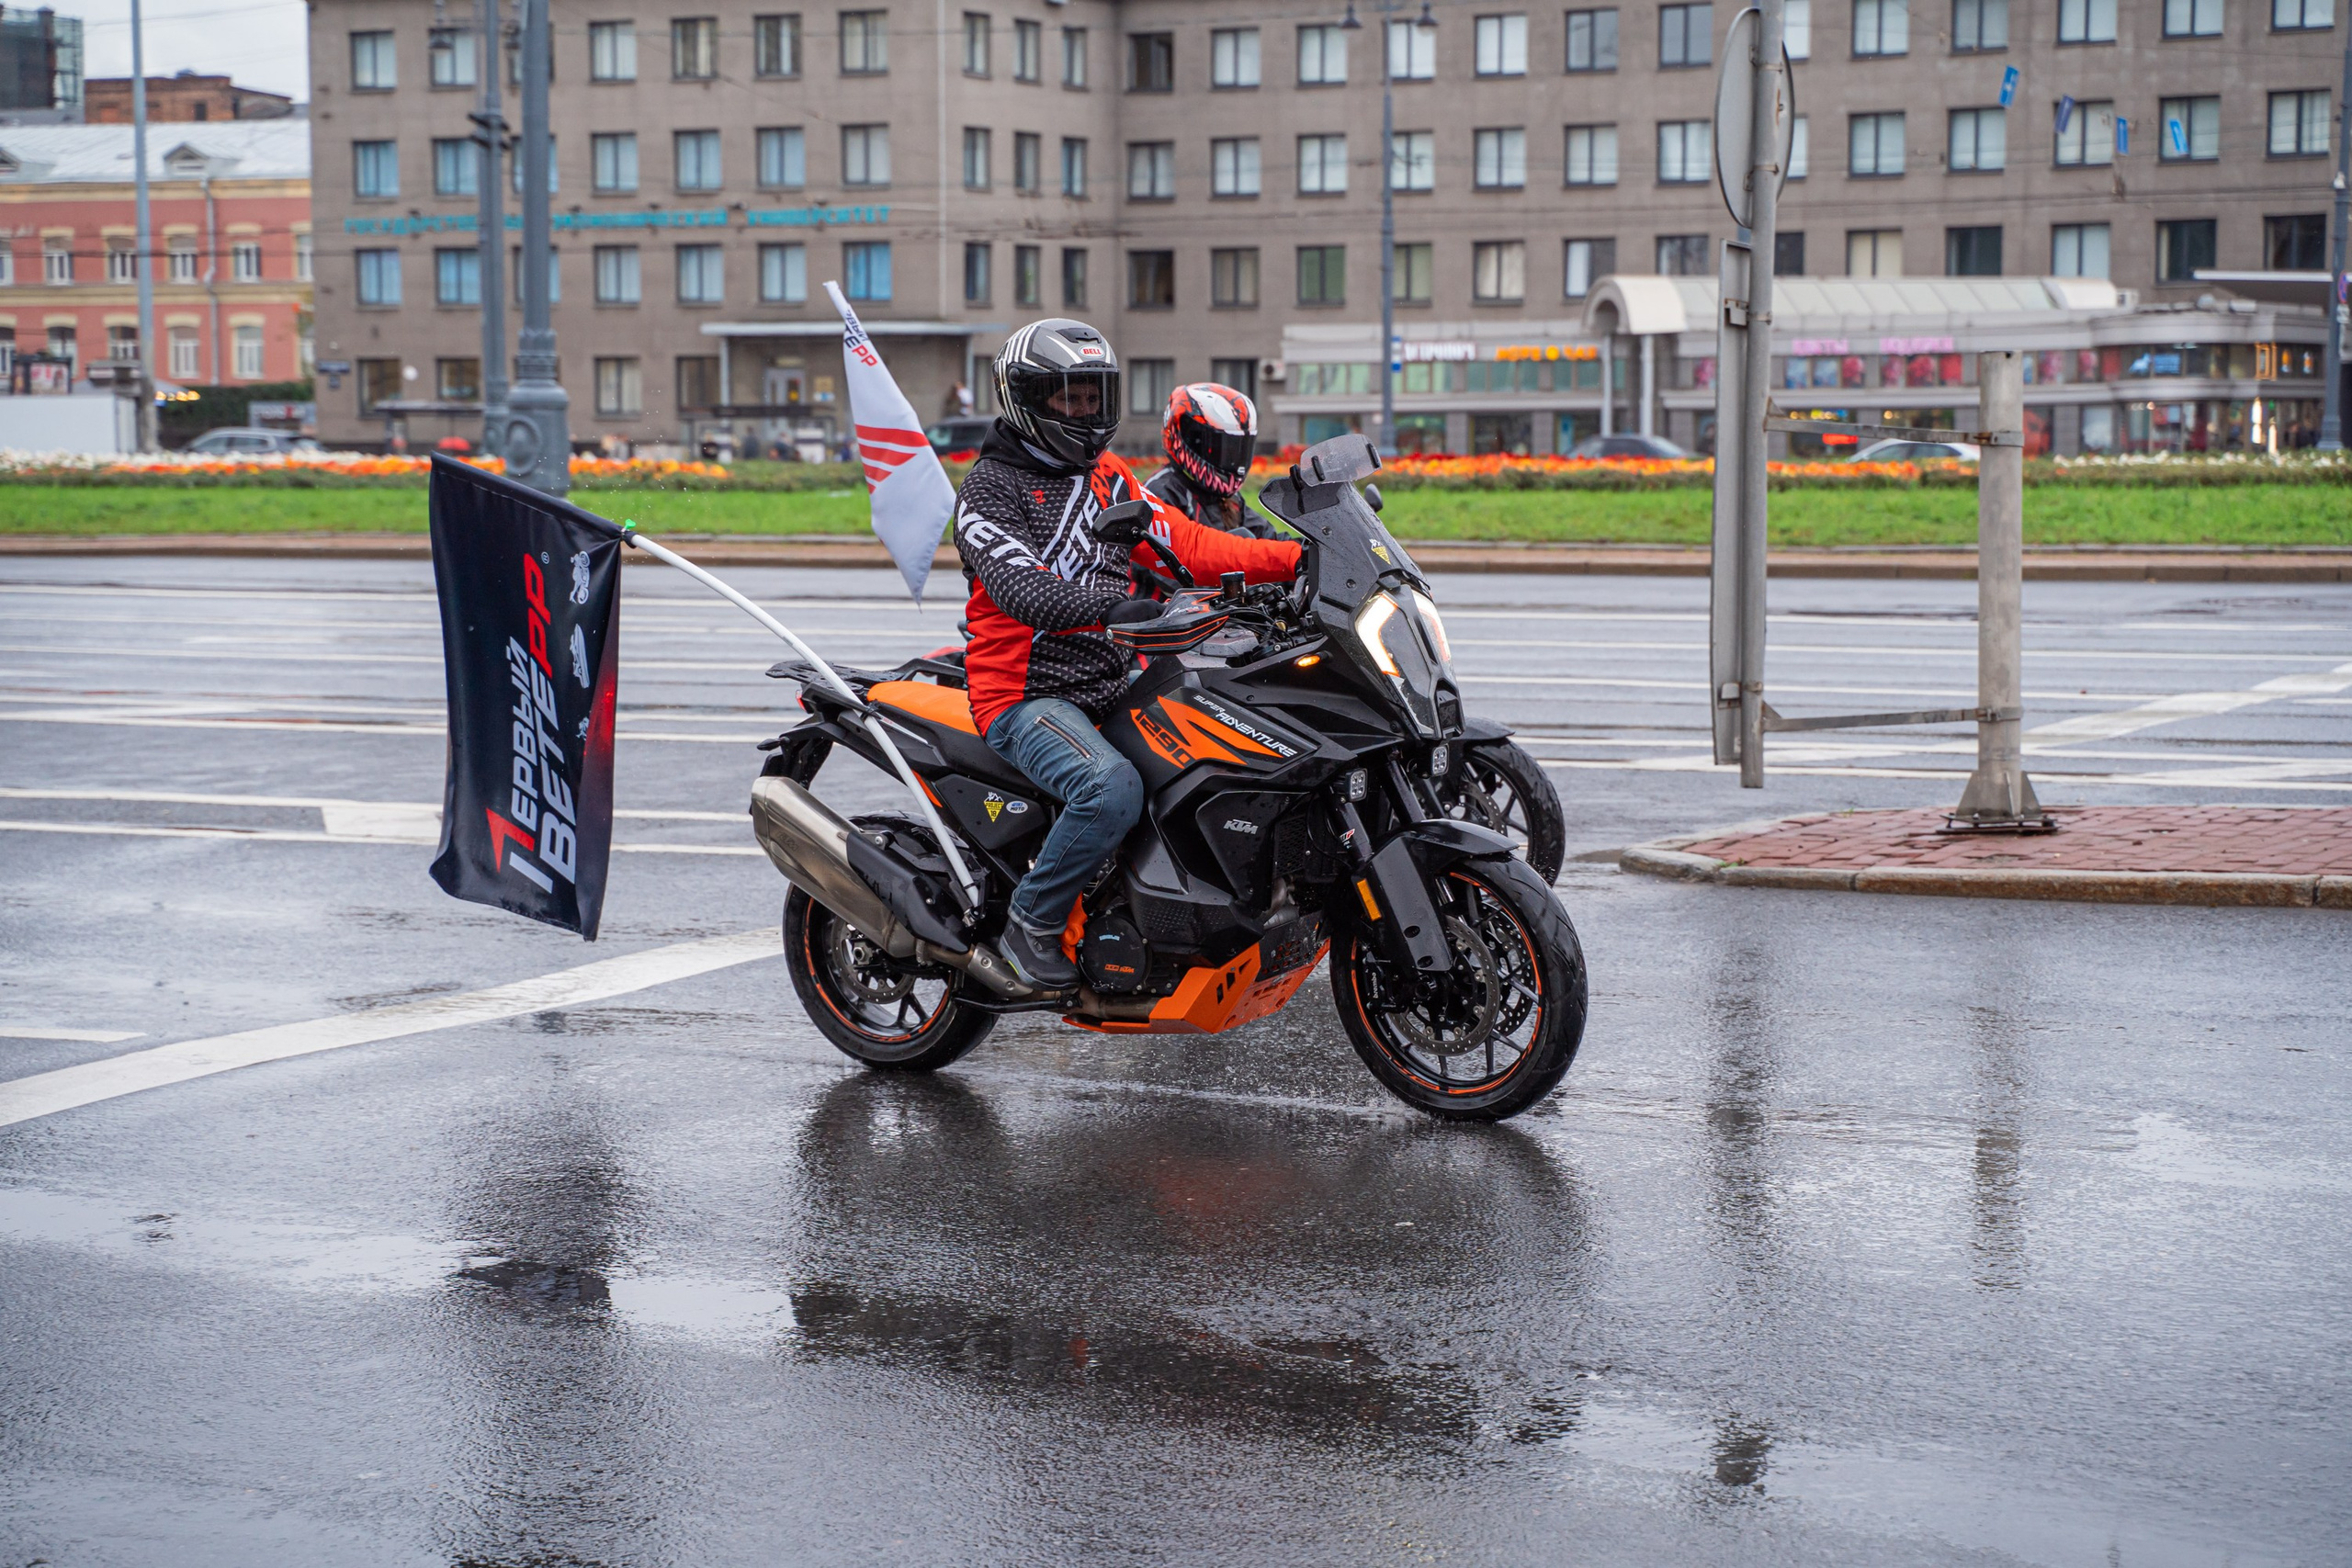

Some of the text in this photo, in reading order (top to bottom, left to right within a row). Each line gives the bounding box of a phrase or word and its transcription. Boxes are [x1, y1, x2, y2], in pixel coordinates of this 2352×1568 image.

[523, 552, 577, 886] ВЕТЕРР
[1193, 694, 1227, 714] SUPER
[1133, 710, 1192, 765] 1290
[1215, 711, 1298, 758] ADVENTURE
[486, 636, 554, 893] ПЕРВЫЙ
[1223, 818, 1259, 835] KTM
